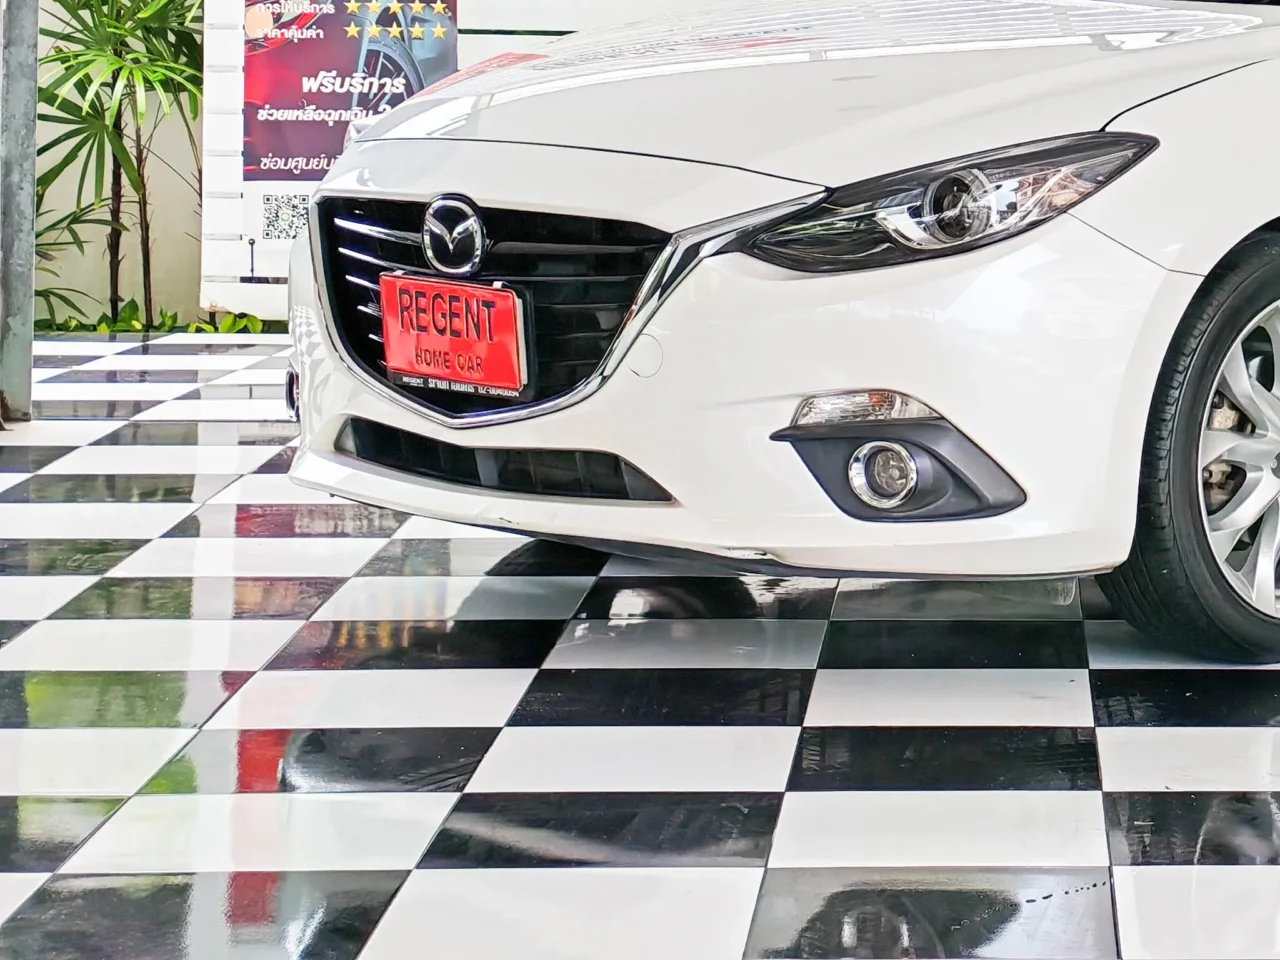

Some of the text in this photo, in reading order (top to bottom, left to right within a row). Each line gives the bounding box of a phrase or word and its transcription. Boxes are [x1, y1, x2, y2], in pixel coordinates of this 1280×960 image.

[255, 0, 336, 15] การให้บริการ
[301, 70, 407, 95] ฟรีบริการ
[398, 286, 496, 344] REGENT
[415, 346, 484, 376] HOME CAR
